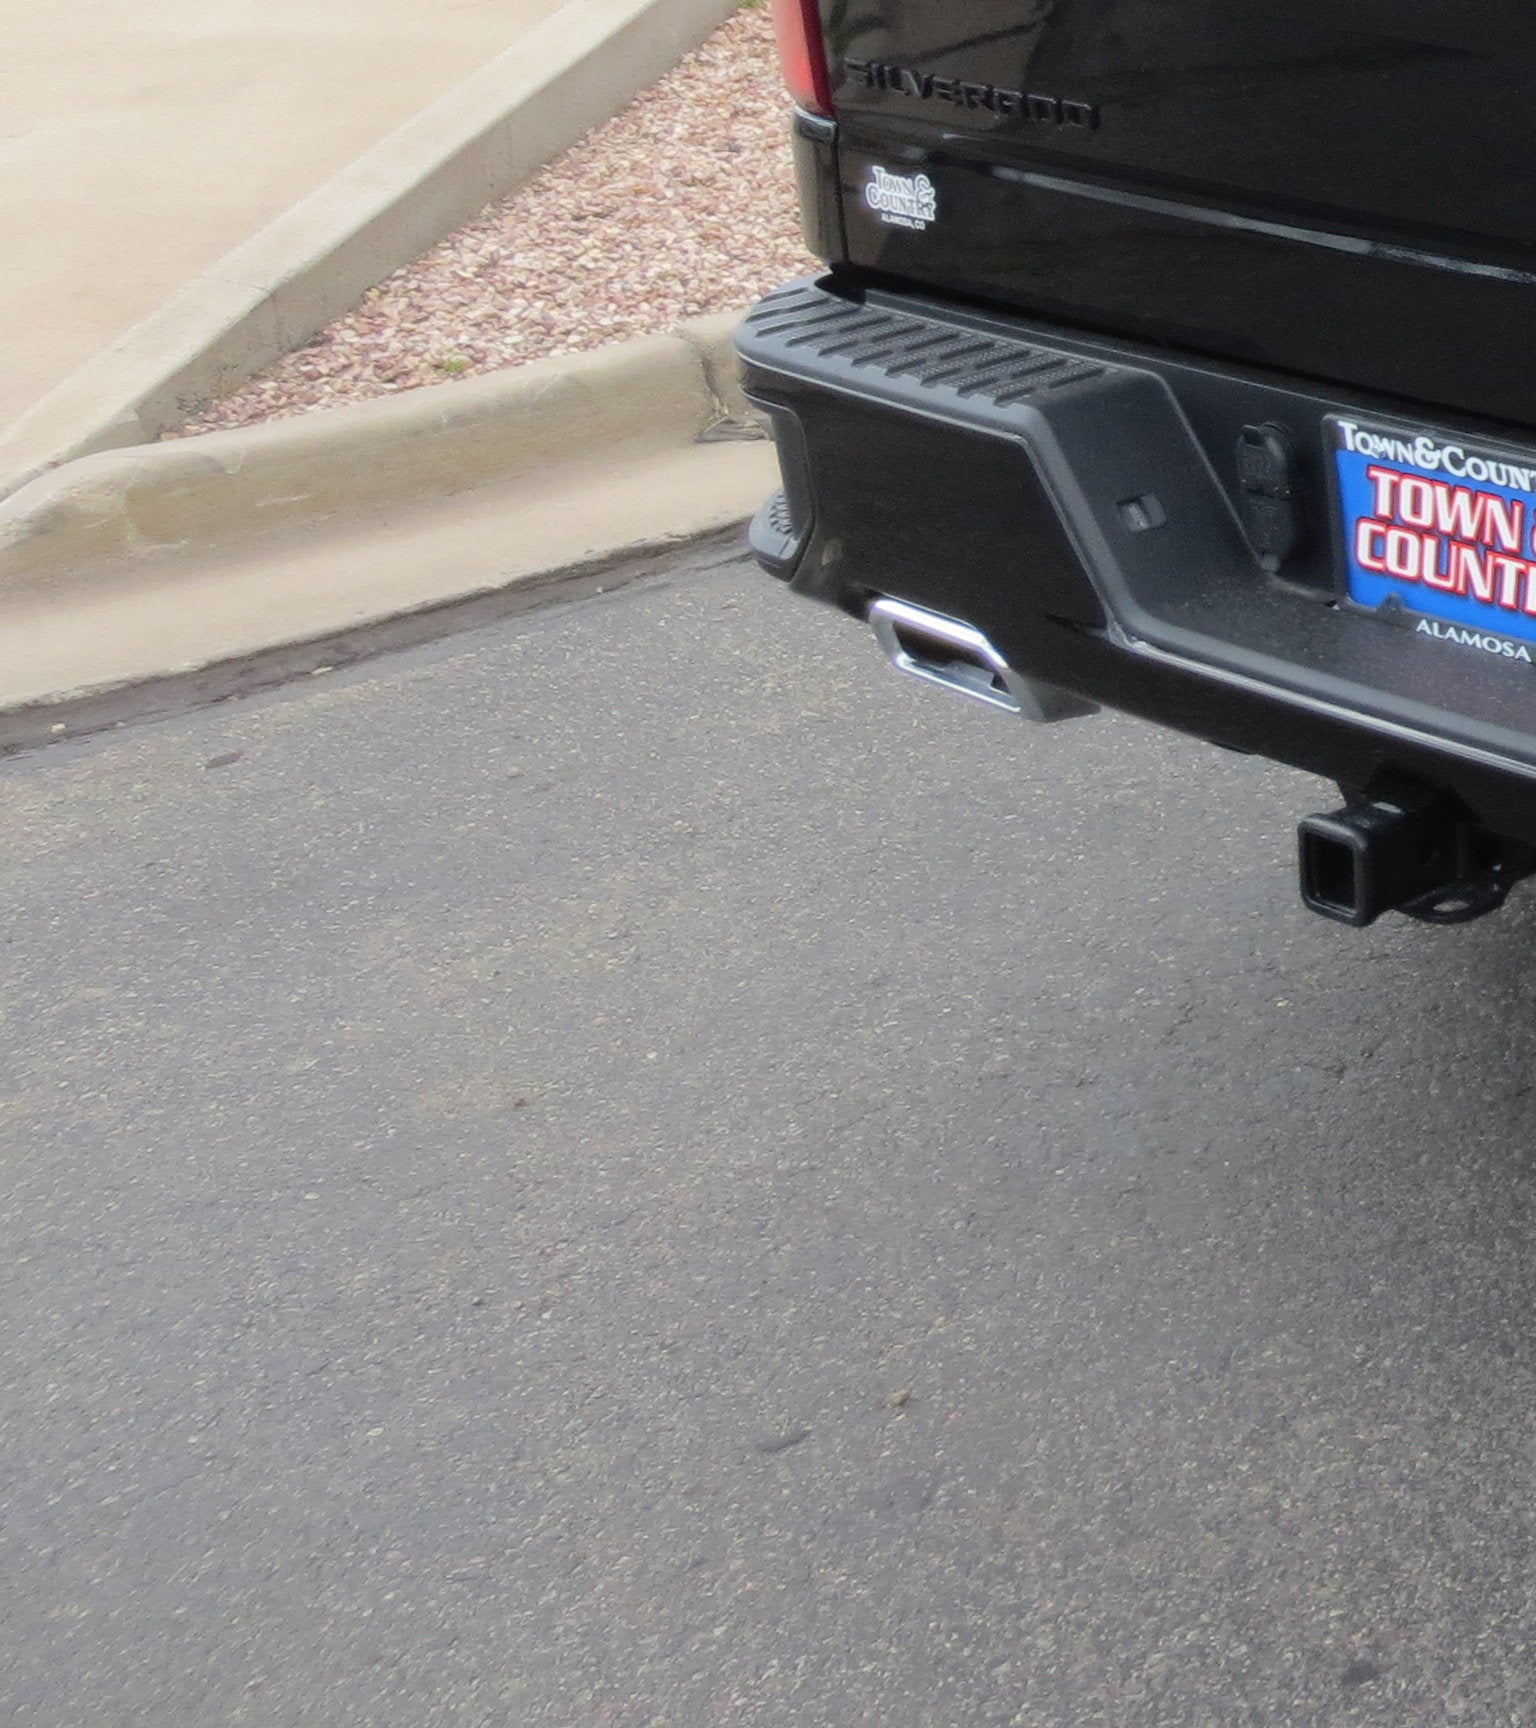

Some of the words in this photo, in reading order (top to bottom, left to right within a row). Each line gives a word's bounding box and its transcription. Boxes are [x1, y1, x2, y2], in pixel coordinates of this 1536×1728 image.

[845, 56, 1100, 132] SILVERADO
[866, 183, 936, 221] COUNTRY
[873, 165, 914, 196] TOWN
[1367, 465, 1523, 553] TOWN
[1416, 618, 1532, 663] ALAMOSA
